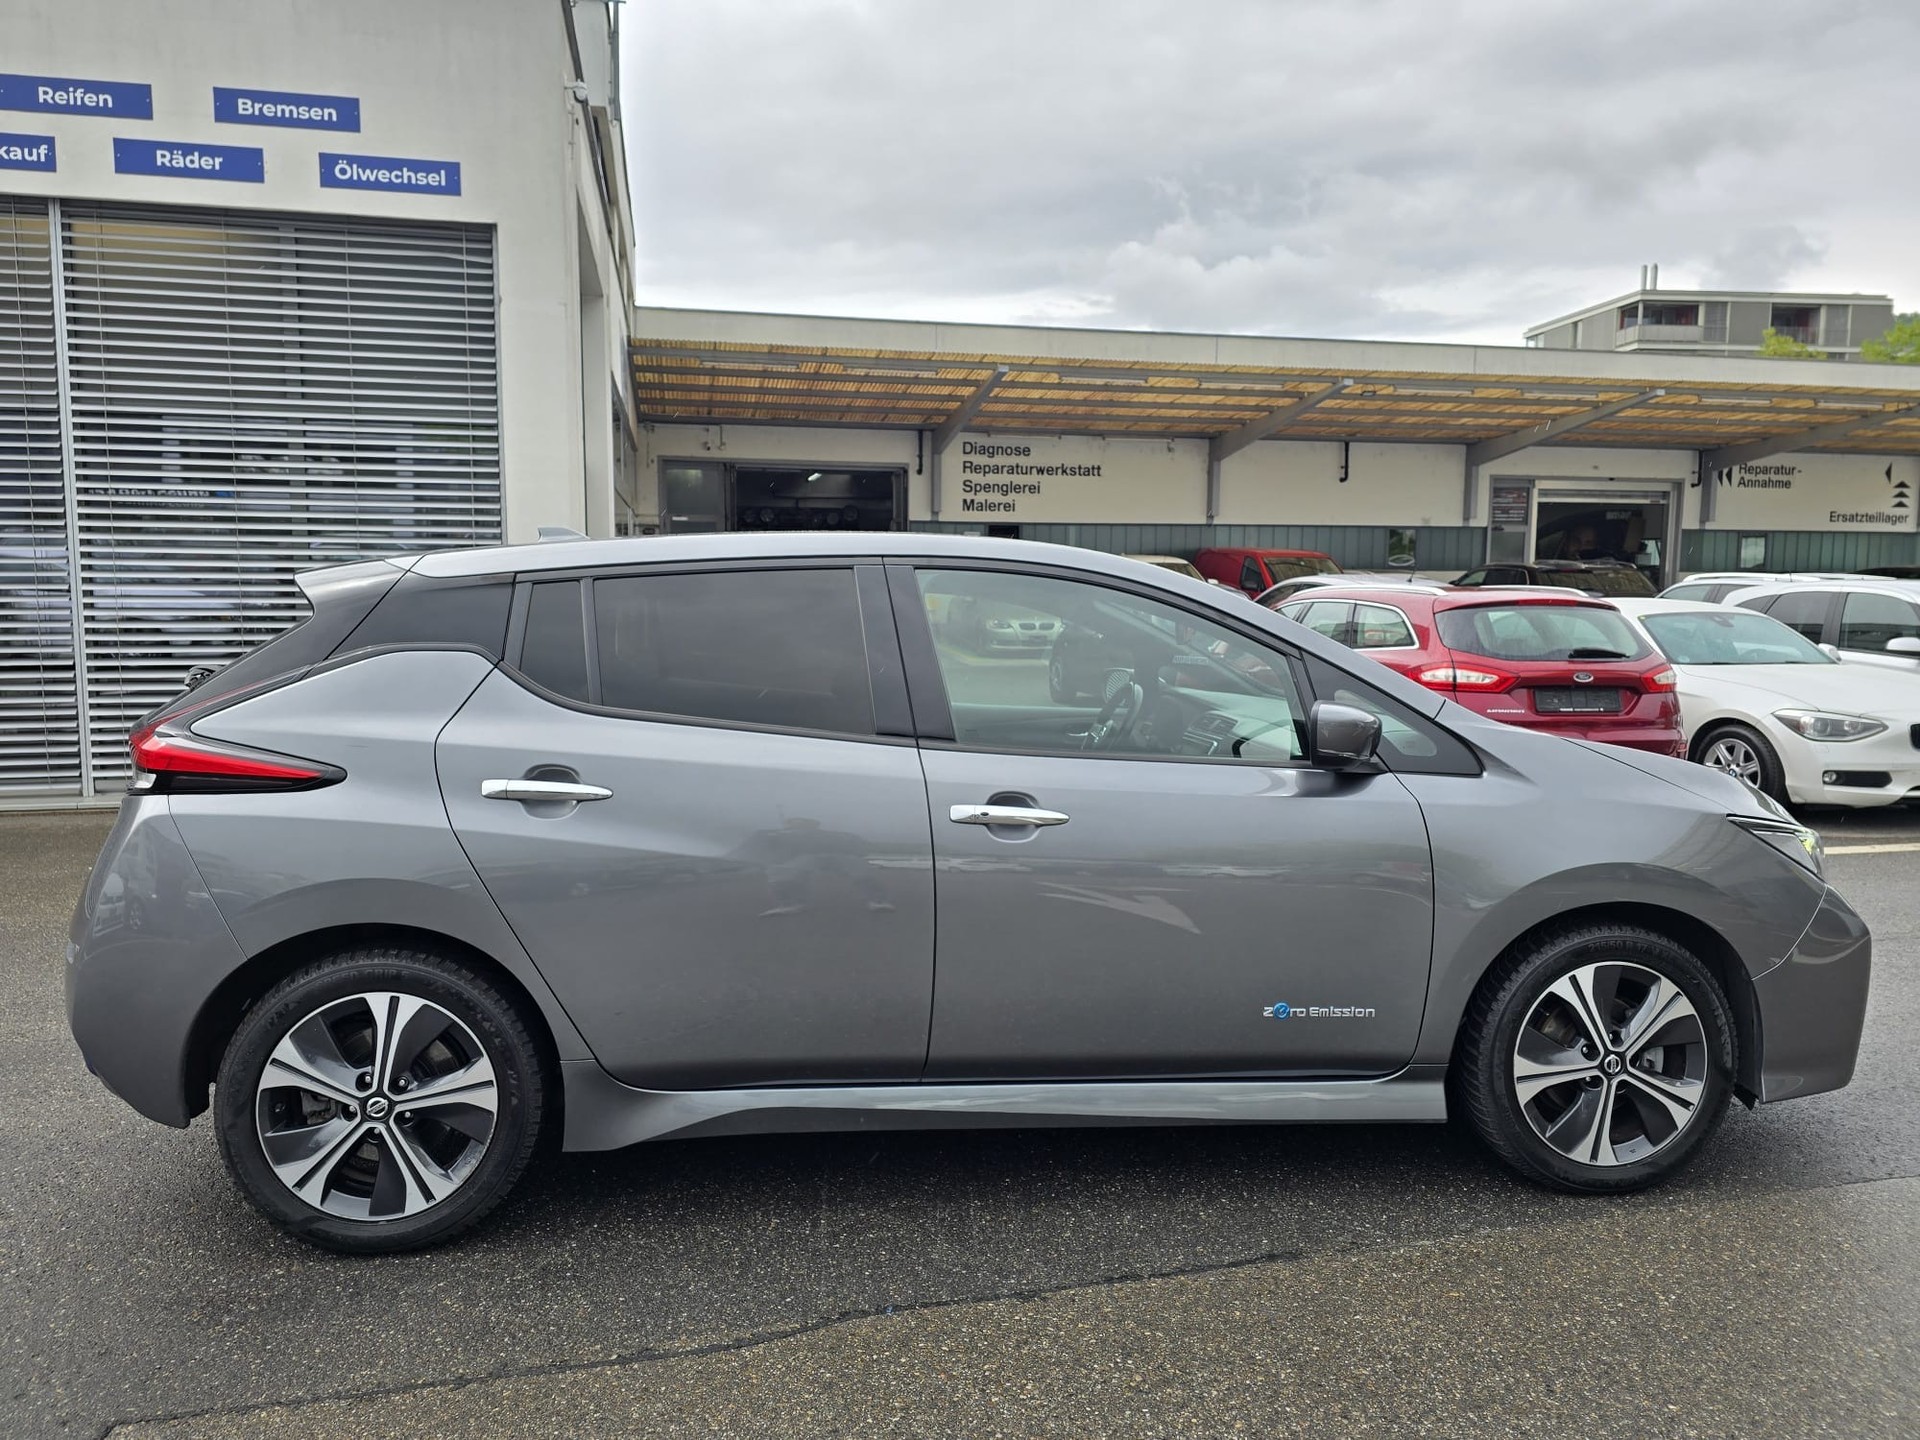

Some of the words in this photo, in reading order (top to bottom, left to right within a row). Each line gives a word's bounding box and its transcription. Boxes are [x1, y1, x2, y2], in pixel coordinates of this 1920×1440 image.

[38, 86, 113, 108] Reifen
[237, 98, 337, 122] Bremsen
[156, 150, 223, 171] Räder
[334, 160, 446, 187] Ölwechsel
[962, 441, 1031, 458] Diagnose
[962, 461, 1102, 478] Reparaturwerkstatt
[962, 480, 1041, 496] Spenglerei
[1737, 476, 1792, 489] Annahme
[962, 499, 1016, 513] Malerei
[1829, 511, 1909, 526] Ersatzteillager
[1309, 1005, 1376, 1018] Emission
